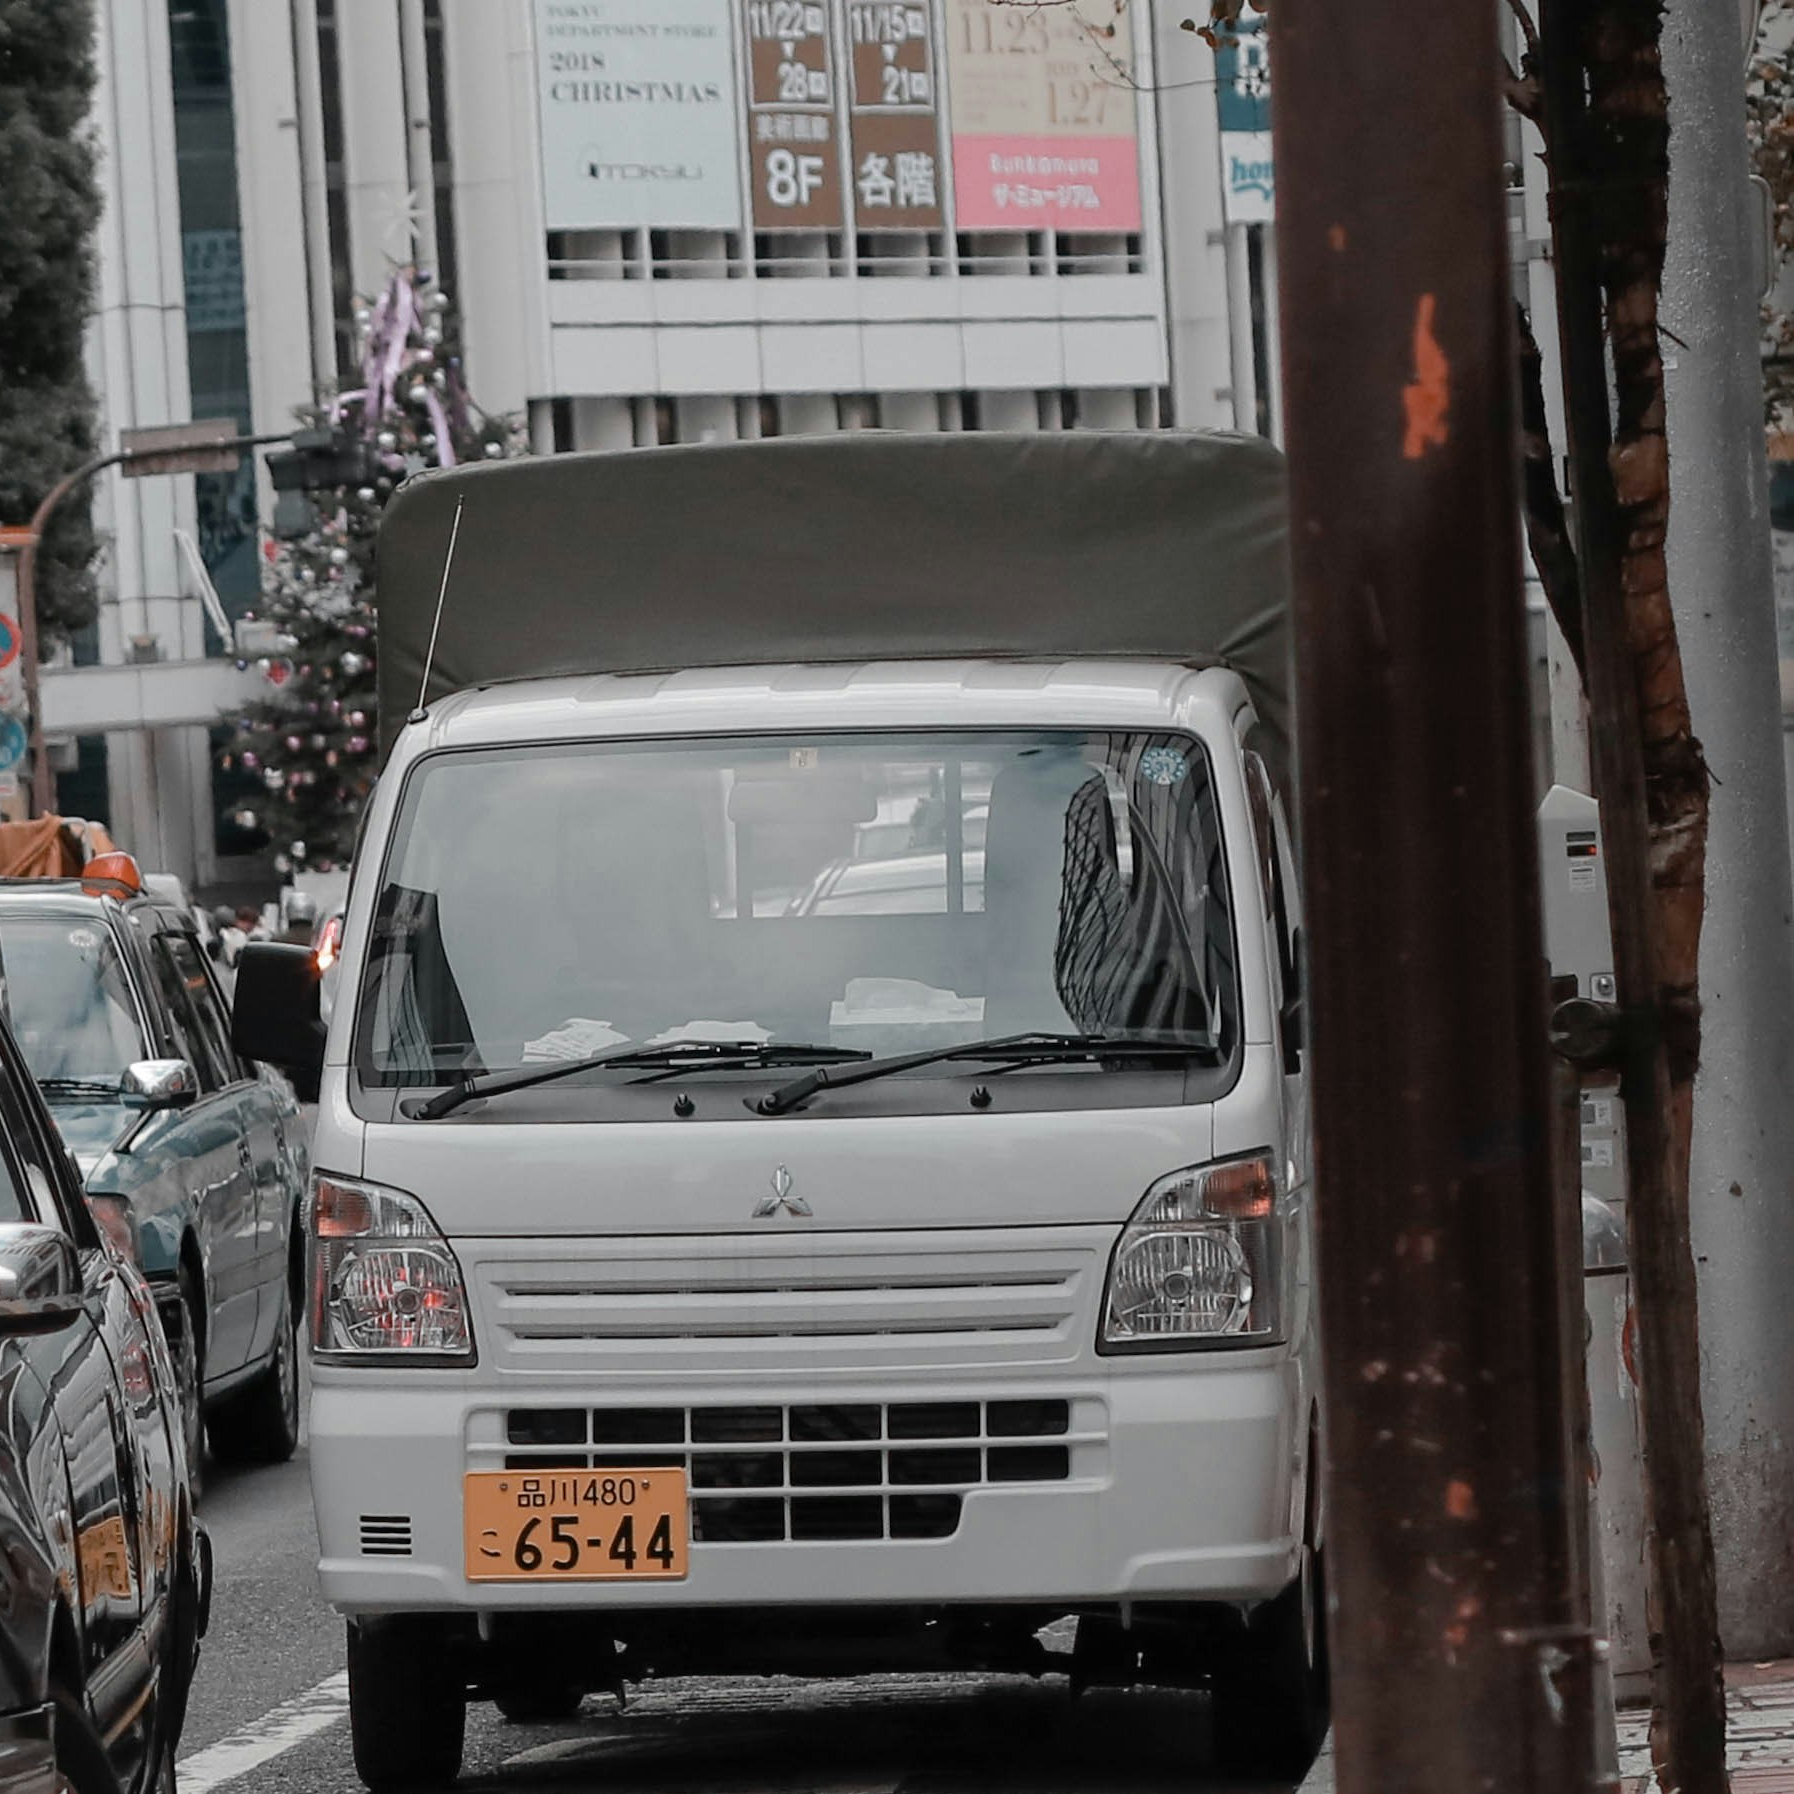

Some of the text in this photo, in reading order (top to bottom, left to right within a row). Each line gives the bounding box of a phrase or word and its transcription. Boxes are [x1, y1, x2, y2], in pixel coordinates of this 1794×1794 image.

[549, 52, 605, 72] 2018
[550, 82, 720, 103] CHRISTMAS
[765, 148, 824, 208] 8F
[858, 151, 937, 208] 各階
[517, 1477, 637, 1508] 品川 480
[479, 1513, 675, 1572] こ 65-44
